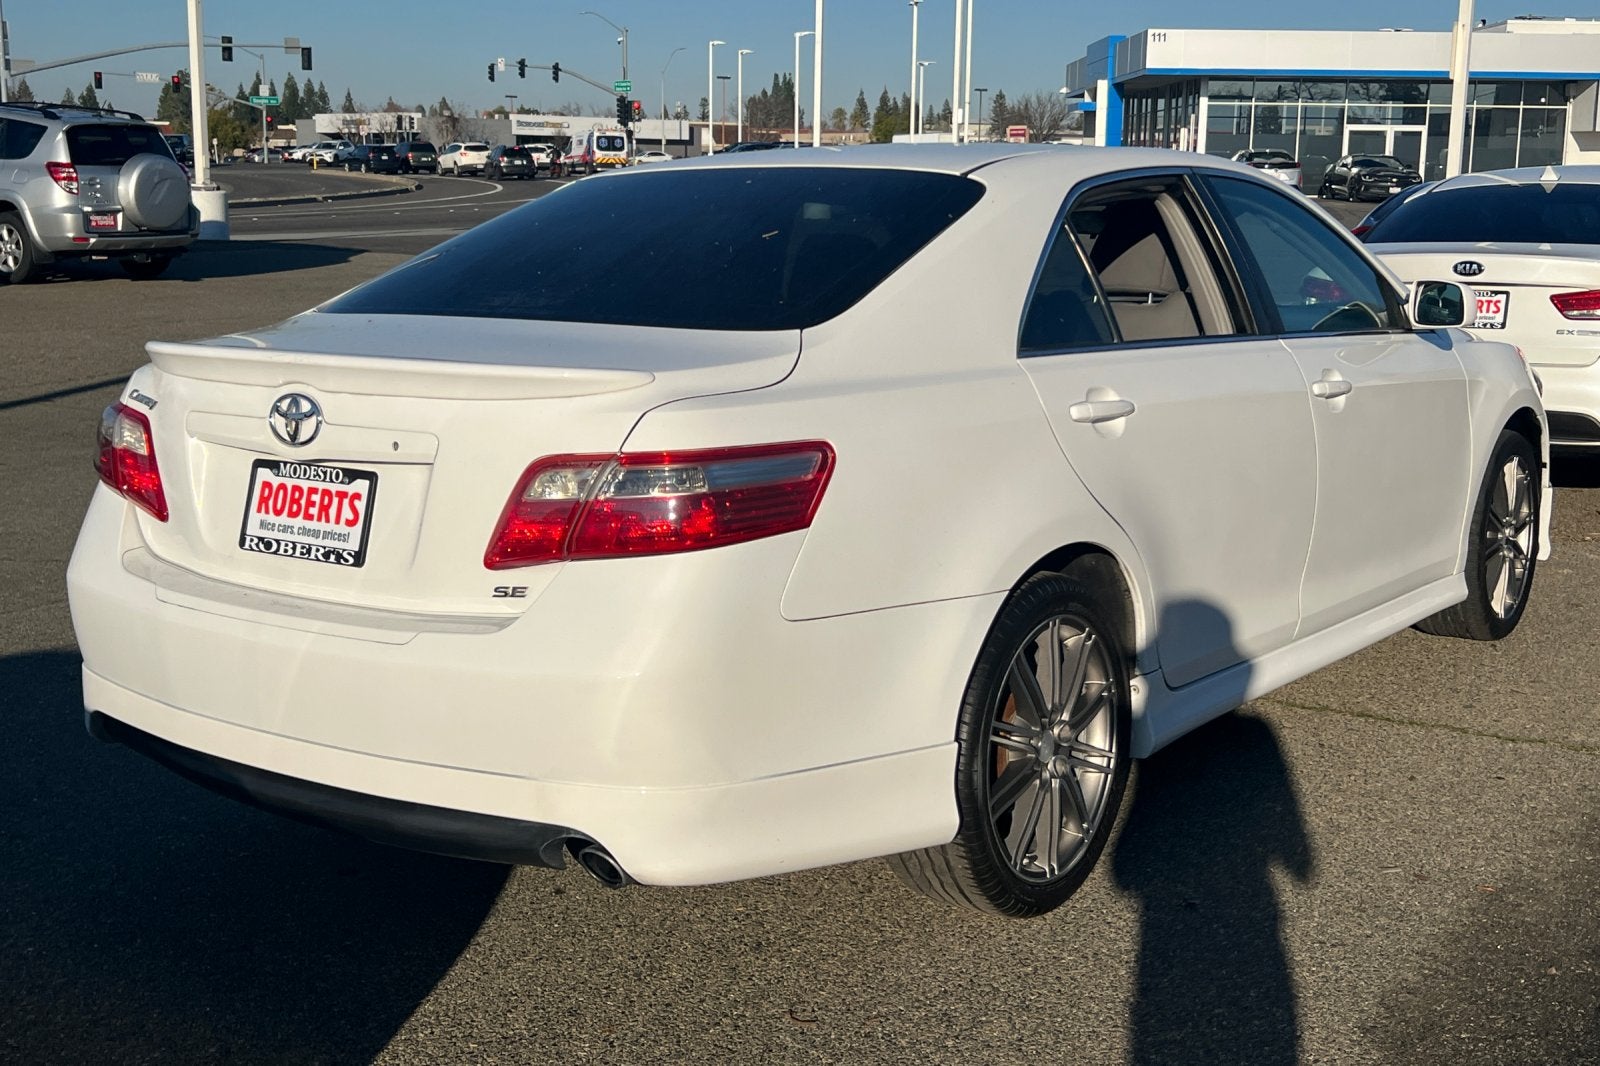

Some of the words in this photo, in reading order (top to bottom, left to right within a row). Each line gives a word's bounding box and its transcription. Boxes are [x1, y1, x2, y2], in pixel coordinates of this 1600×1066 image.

[1151, 32, 1167, 43] 111
[1457, 263, 1480, 274] KIA
[279, 462, 344, 484] MODESTO
[256, 480, 363, 528] ROBERTS
[259, 519, 275, 532] Nice
[277, 523, 296, 536] cars,
[297, 526, 321, 540] cheap
[322, 530, 350, 543] prices!
[242, 535, 356, 566] ROBERTS
[492, 586, 529, 598] SE
